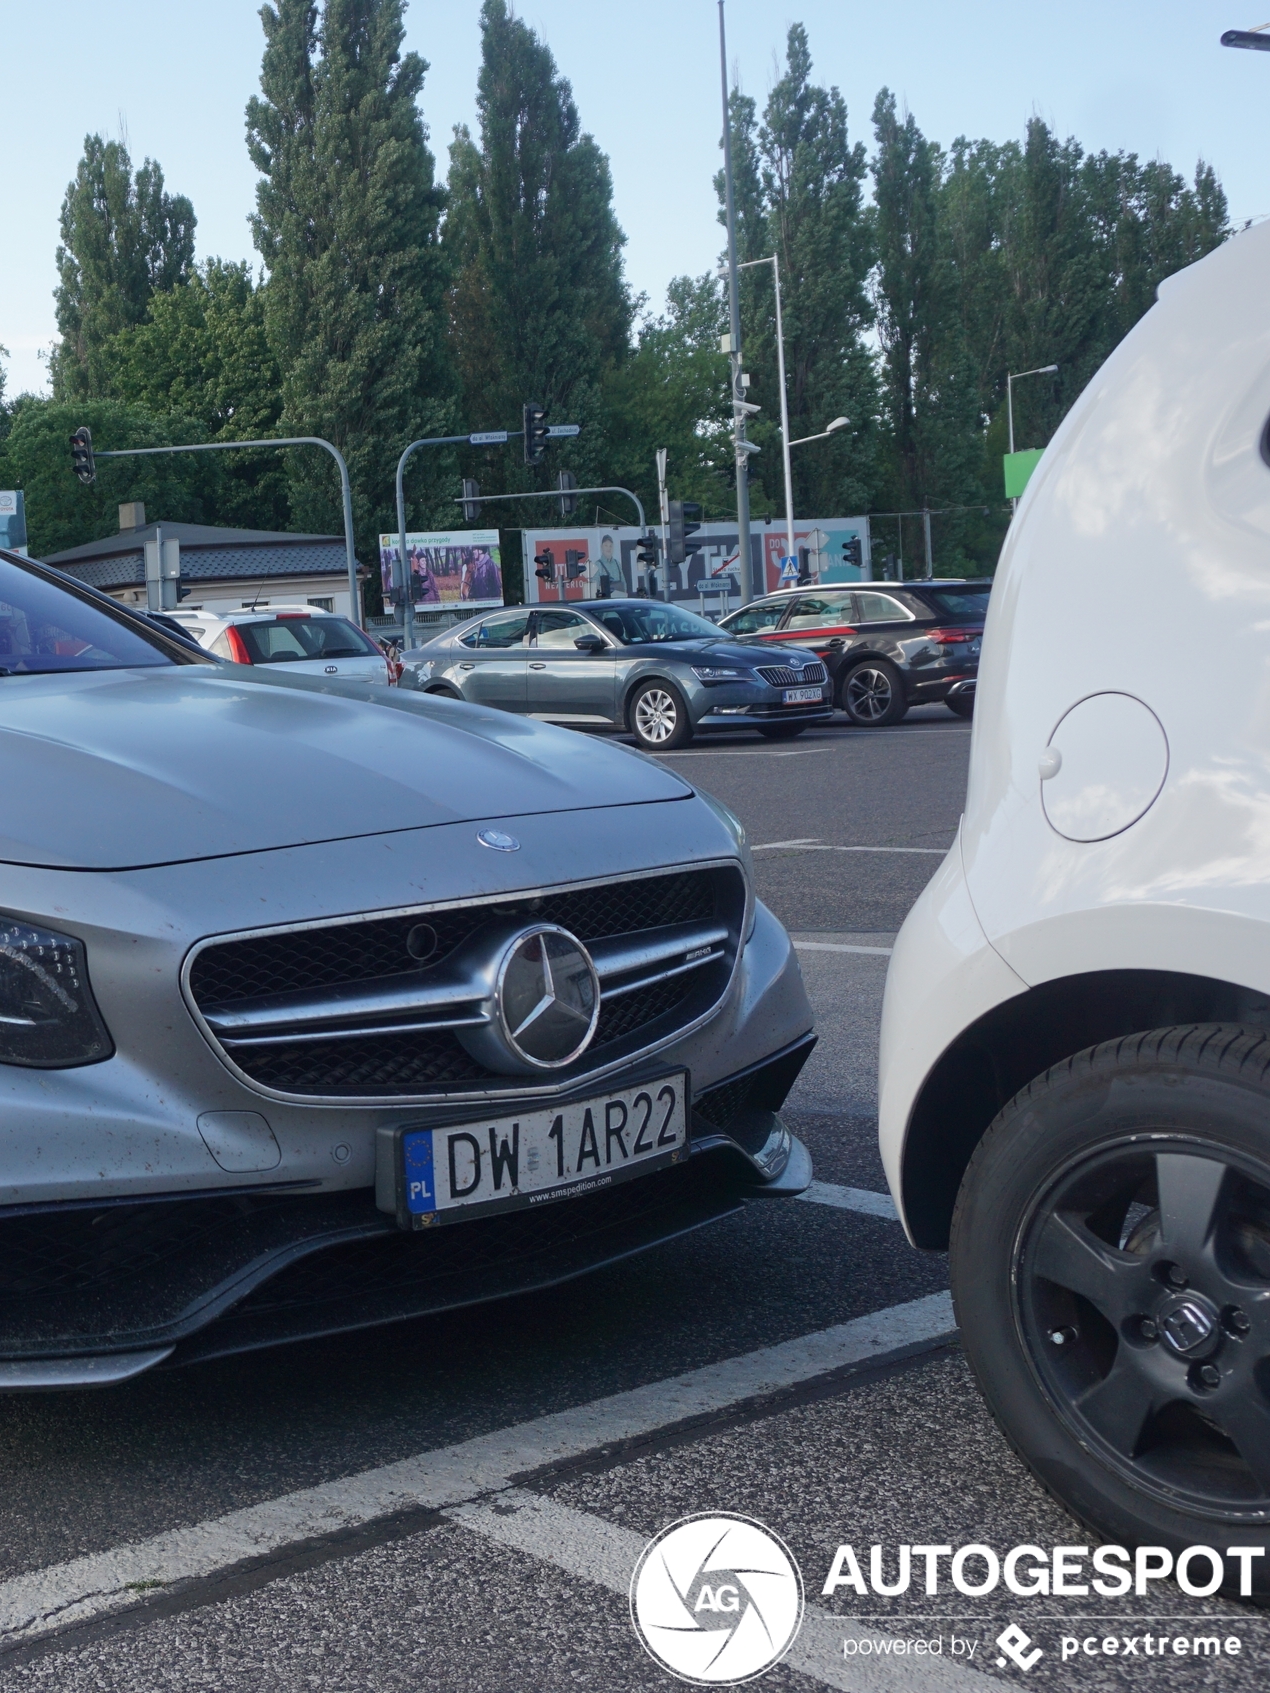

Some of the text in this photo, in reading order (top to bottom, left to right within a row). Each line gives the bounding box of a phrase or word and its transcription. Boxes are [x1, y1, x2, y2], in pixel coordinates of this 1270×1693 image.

[428, 536, 450, 545] przygody
[769, 539, 780, 549] DO
[788, 689, 821, 701] WX 902XG
[447, 1083, 677, 1199] DW 1AR22
[410, 1181, 432, 1200] PL
[529, 1175, 612, 1204] www.smspedition.com
